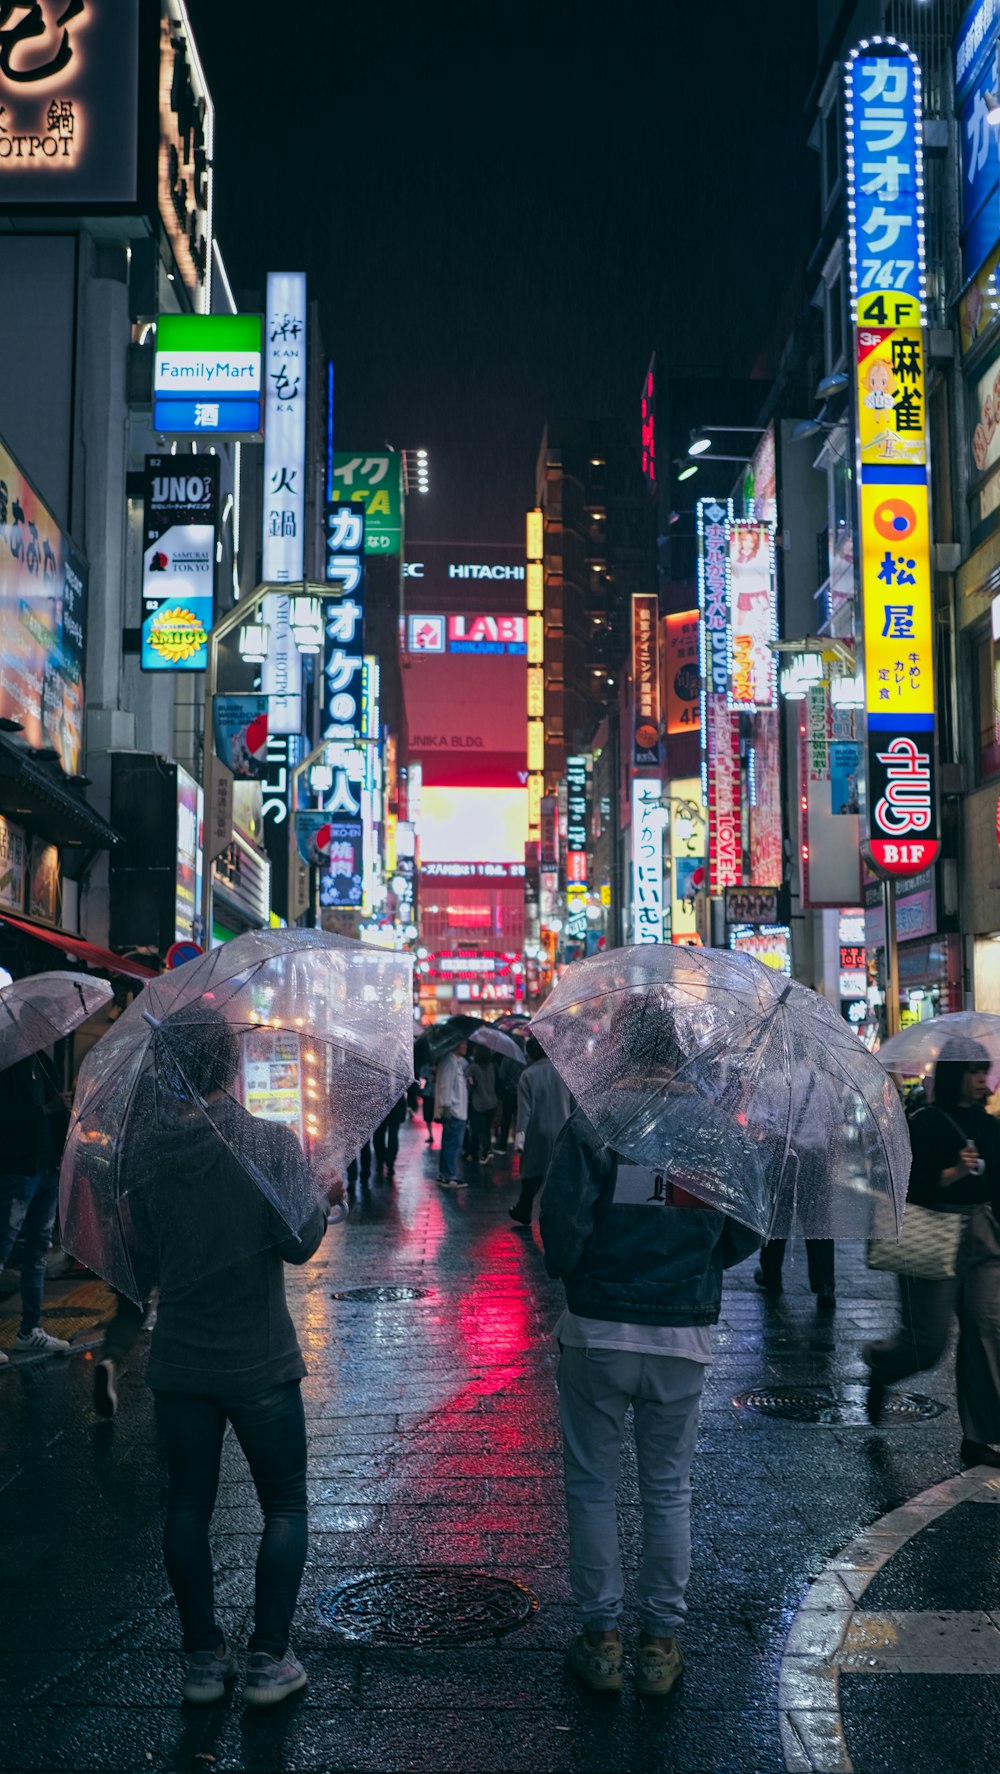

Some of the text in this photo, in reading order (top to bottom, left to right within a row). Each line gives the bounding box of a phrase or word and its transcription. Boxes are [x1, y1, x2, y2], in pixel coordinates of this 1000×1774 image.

[859, 58, 912, 253] カラオケ
[861, 259, 914, 289] 747
[863, 294, 913, 326] 4F
[859, 331, 882, 347] 3F
[273, 350, 299, 358] KAN
[160, 361, 255, 381] FamilyMart
[891, 336, 923, 432] 麻雀
[193, 403, 220, 428] 酒
[276, 404, 294, 412] KA
[333, 457, 389, 485] イク
[269, 467, 299, 538] 火鍋
[172, 551, 209, 560] SAMURAI
[172, 563, 210, 573] TOKYO
[449, 564, 525, 580] HITACHI
[705, 523, 727, 630] ホテルがライバル
[145, 600, 159, 611] B2
[876, 551, 917, 640] 松屋
[877, 668, 891, 701] 定食
[893, 660, 905, 696] カレー
[907, 652, 921, 690] 牛めし
[875, 736, 932, 836] HUB
[883, 844, 924, 864] B1F
